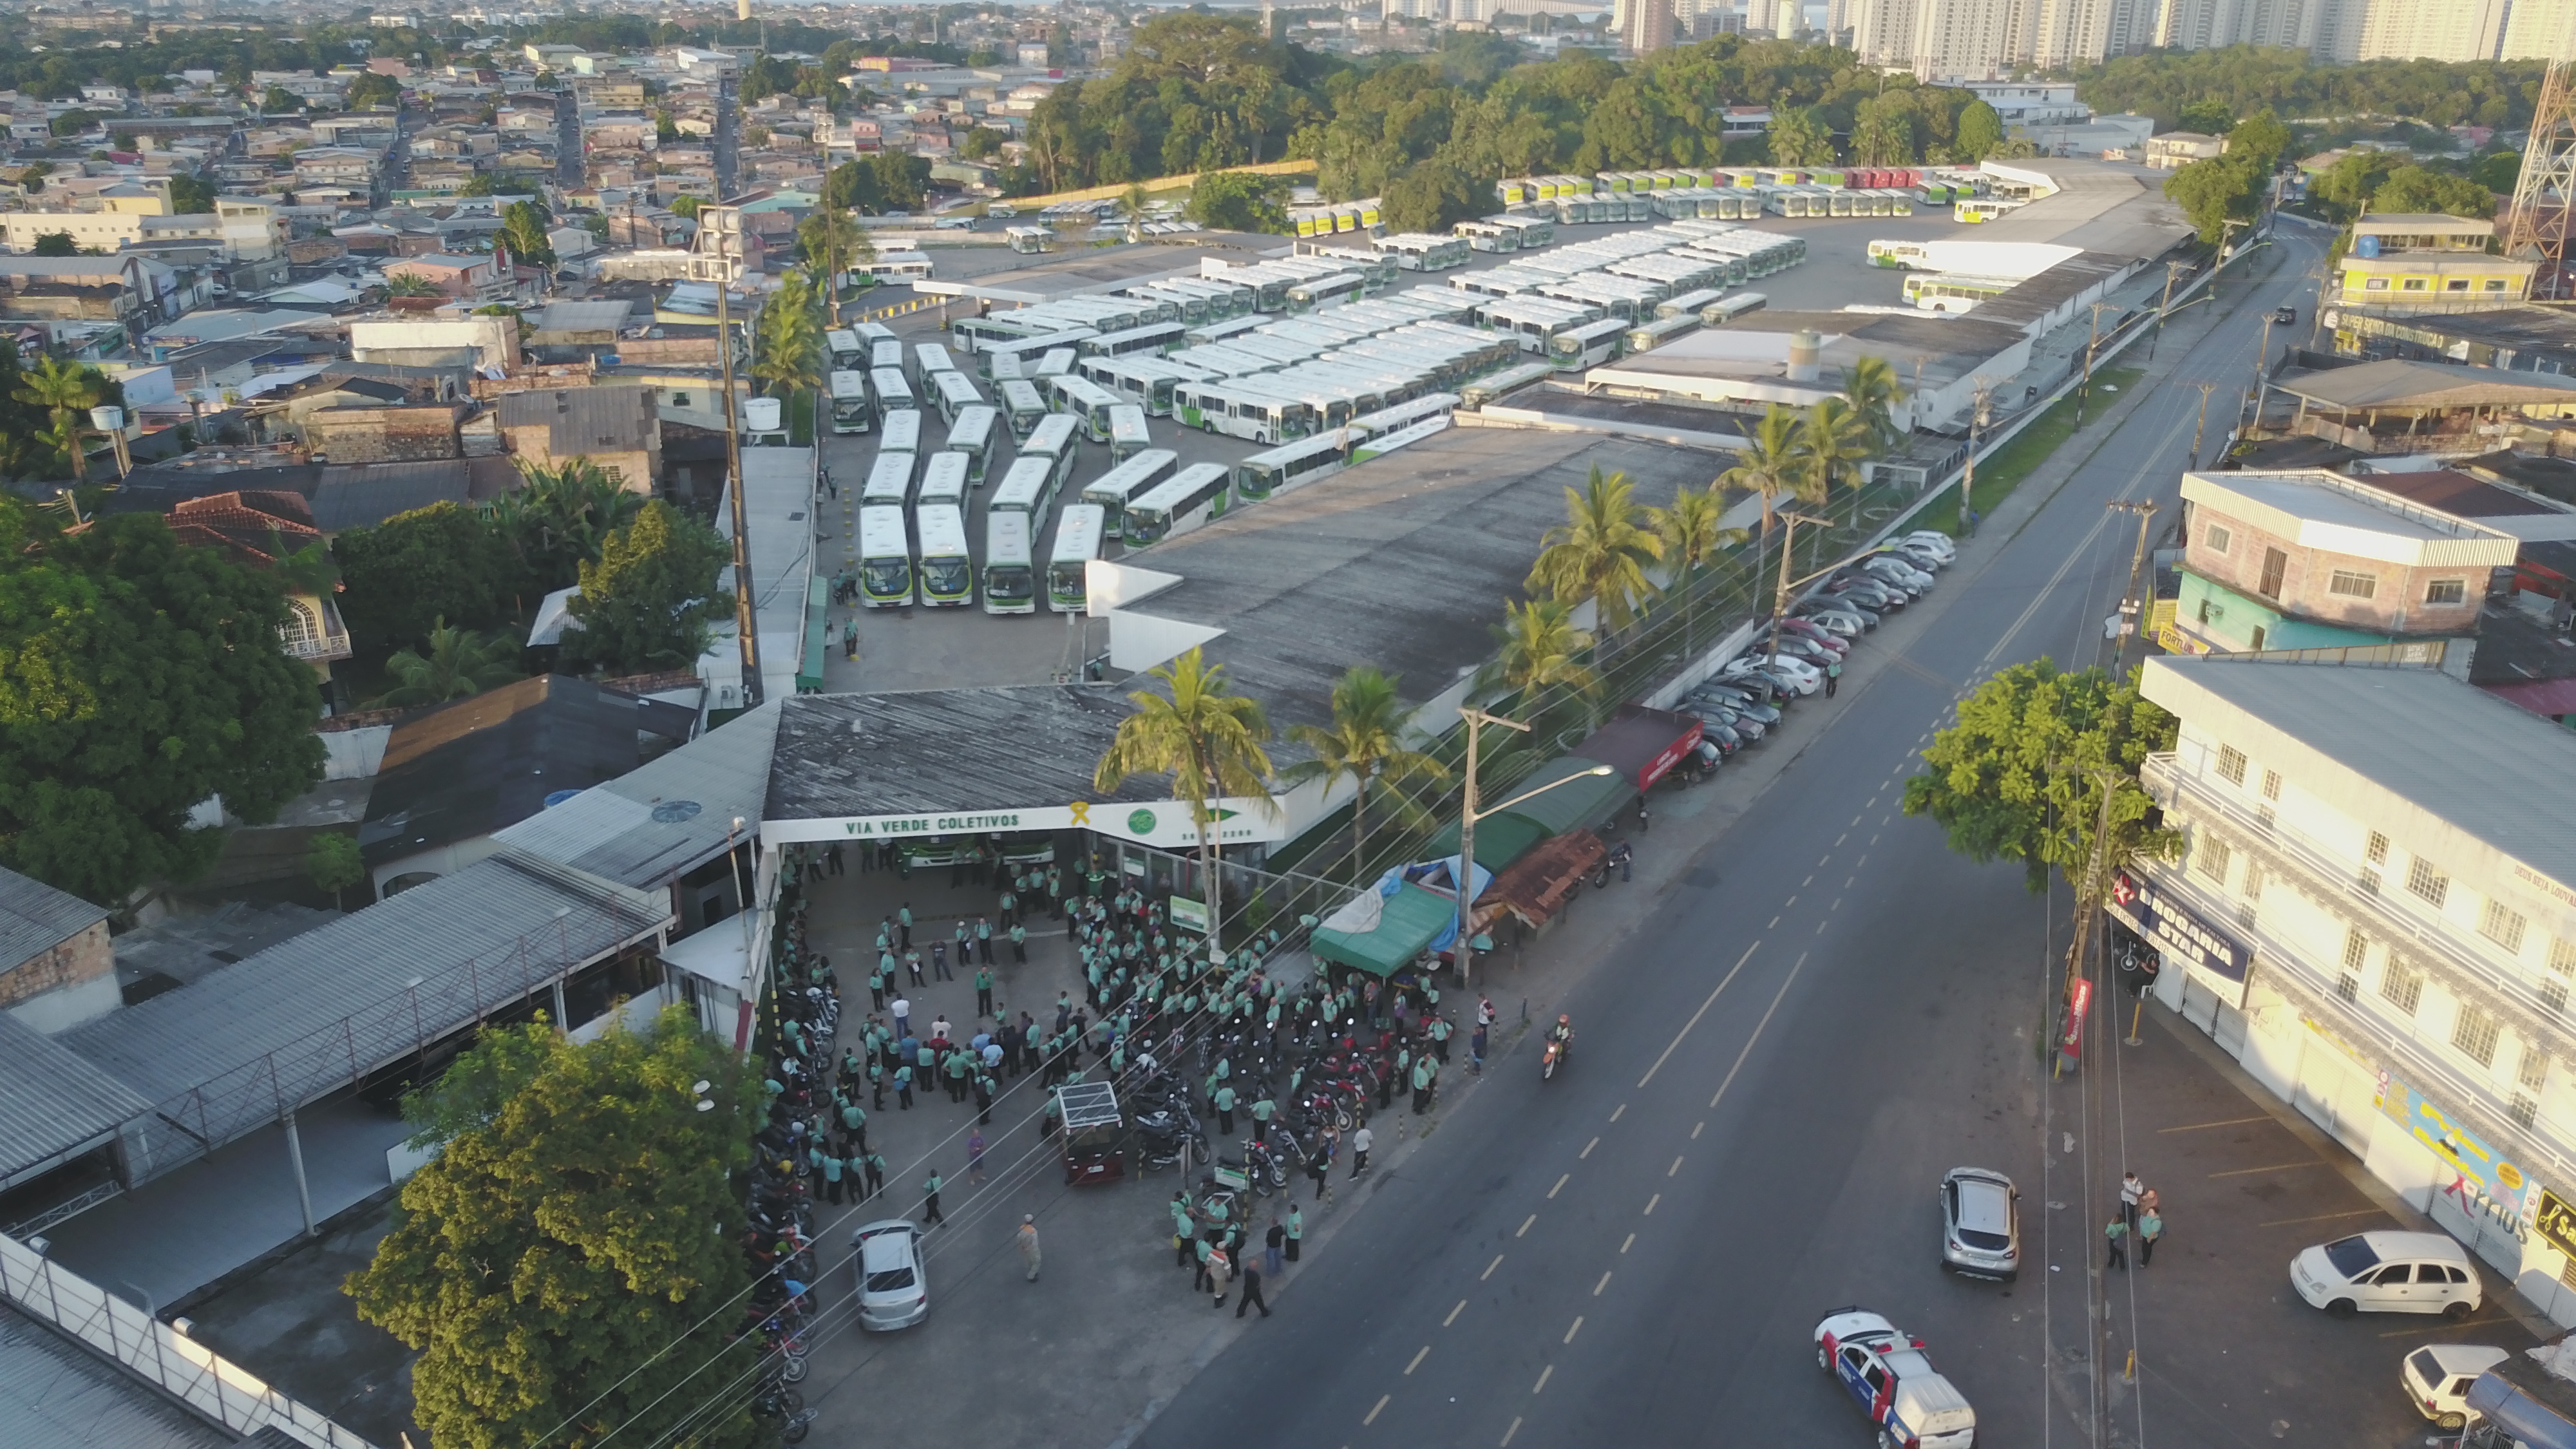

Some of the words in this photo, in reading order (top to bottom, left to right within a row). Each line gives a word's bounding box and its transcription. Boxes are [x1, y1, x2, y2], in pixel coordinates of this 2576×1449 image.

[2342, 313, 2363, 330] SUPER
[2384, 321, 2394, 337] DA
[2161, 630, 2195, 654] FORTLUB
[846, 822, 873, 834] VIA
[882, 819, 929, 833] VERDE
[938, 815, 1019, 829] COLETIVOS
[2514, 865, 2532, 882] DEUS
[2532, 875, 2549, 891] SEJA
[2139, 888, 2233, 967] DROGARIA
[2158, 920, 2205, 964] STAR
